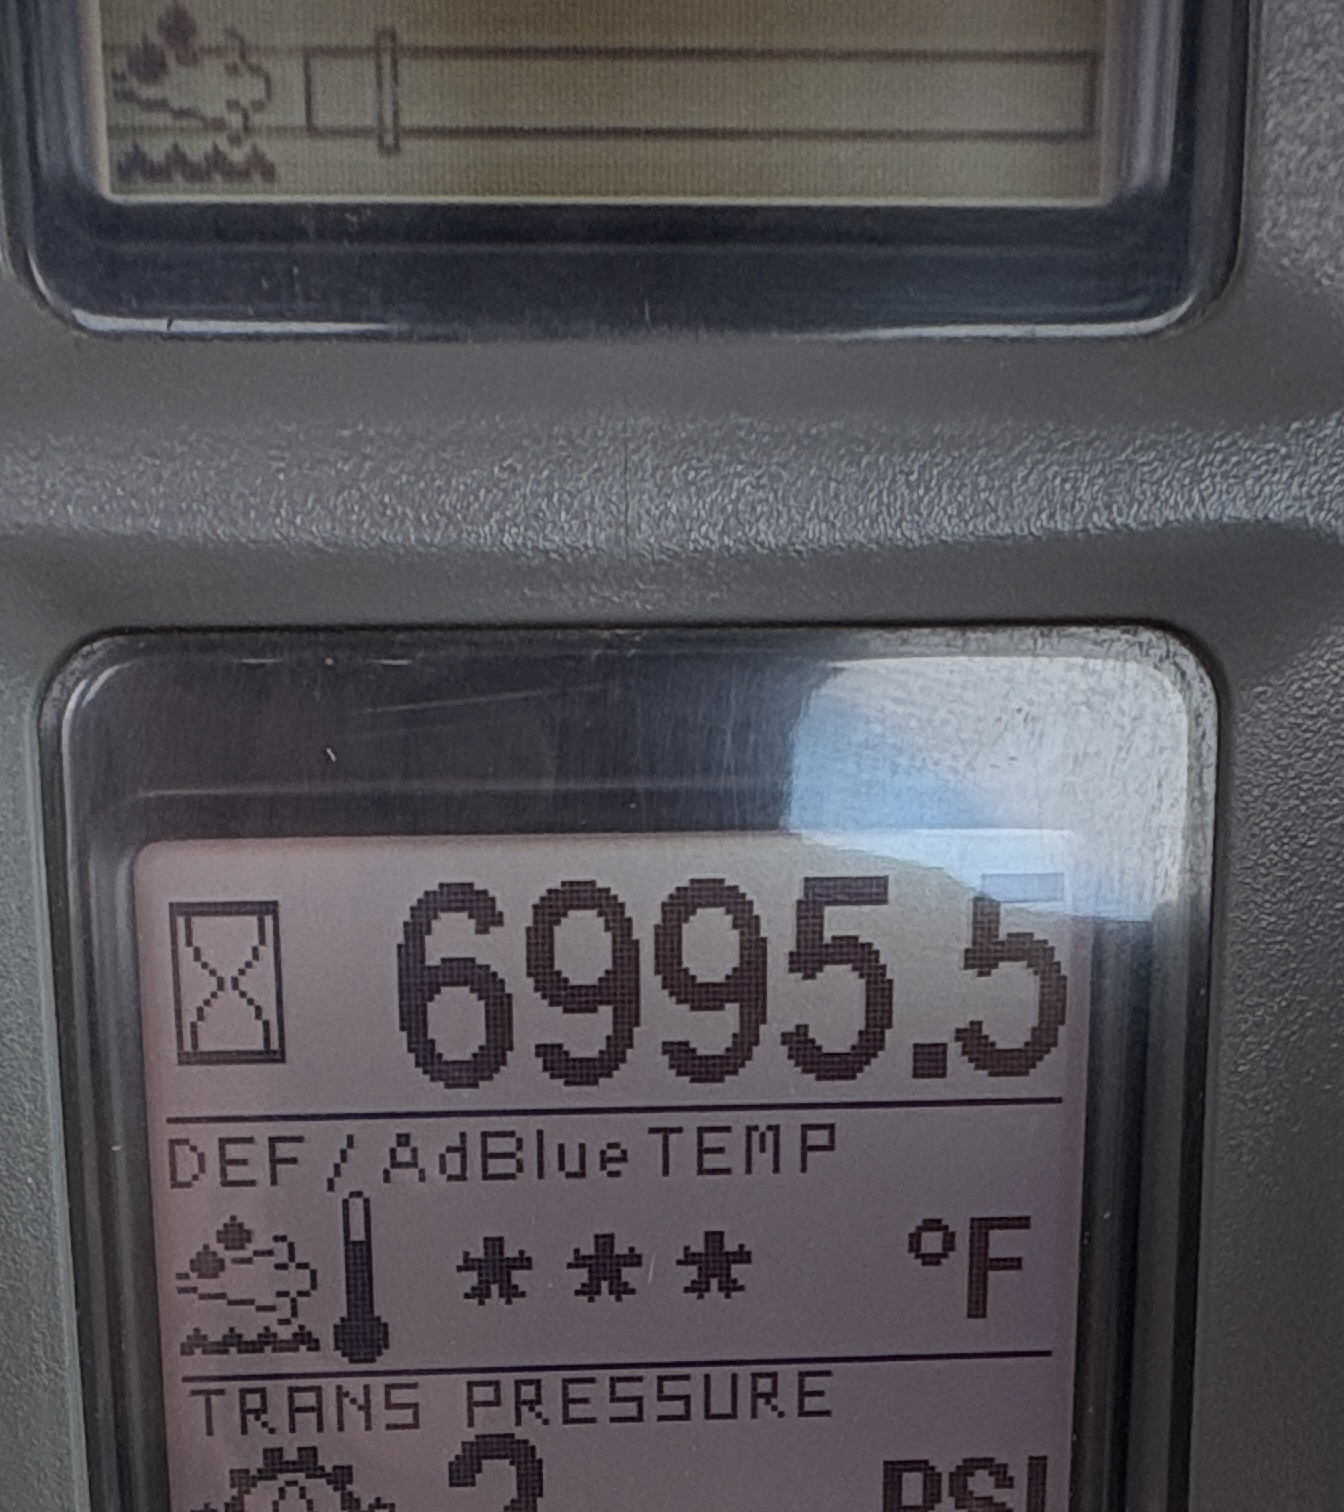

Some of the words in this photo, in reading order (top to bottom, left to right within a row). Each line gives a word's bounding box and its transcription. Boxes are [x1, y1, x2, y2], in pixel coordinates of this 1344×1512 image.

[396, 873, 1068, 1089] 6995.5
[167, 1126, 630, 1194] DEF/AdBlue
[647, 1121, 838, 1179] TEMP
[906, 1215, 1034, 1320] °F
[188, 1380, 422, 1439] TRANS
[465, 1369, 835, 1429] PRESSURE
